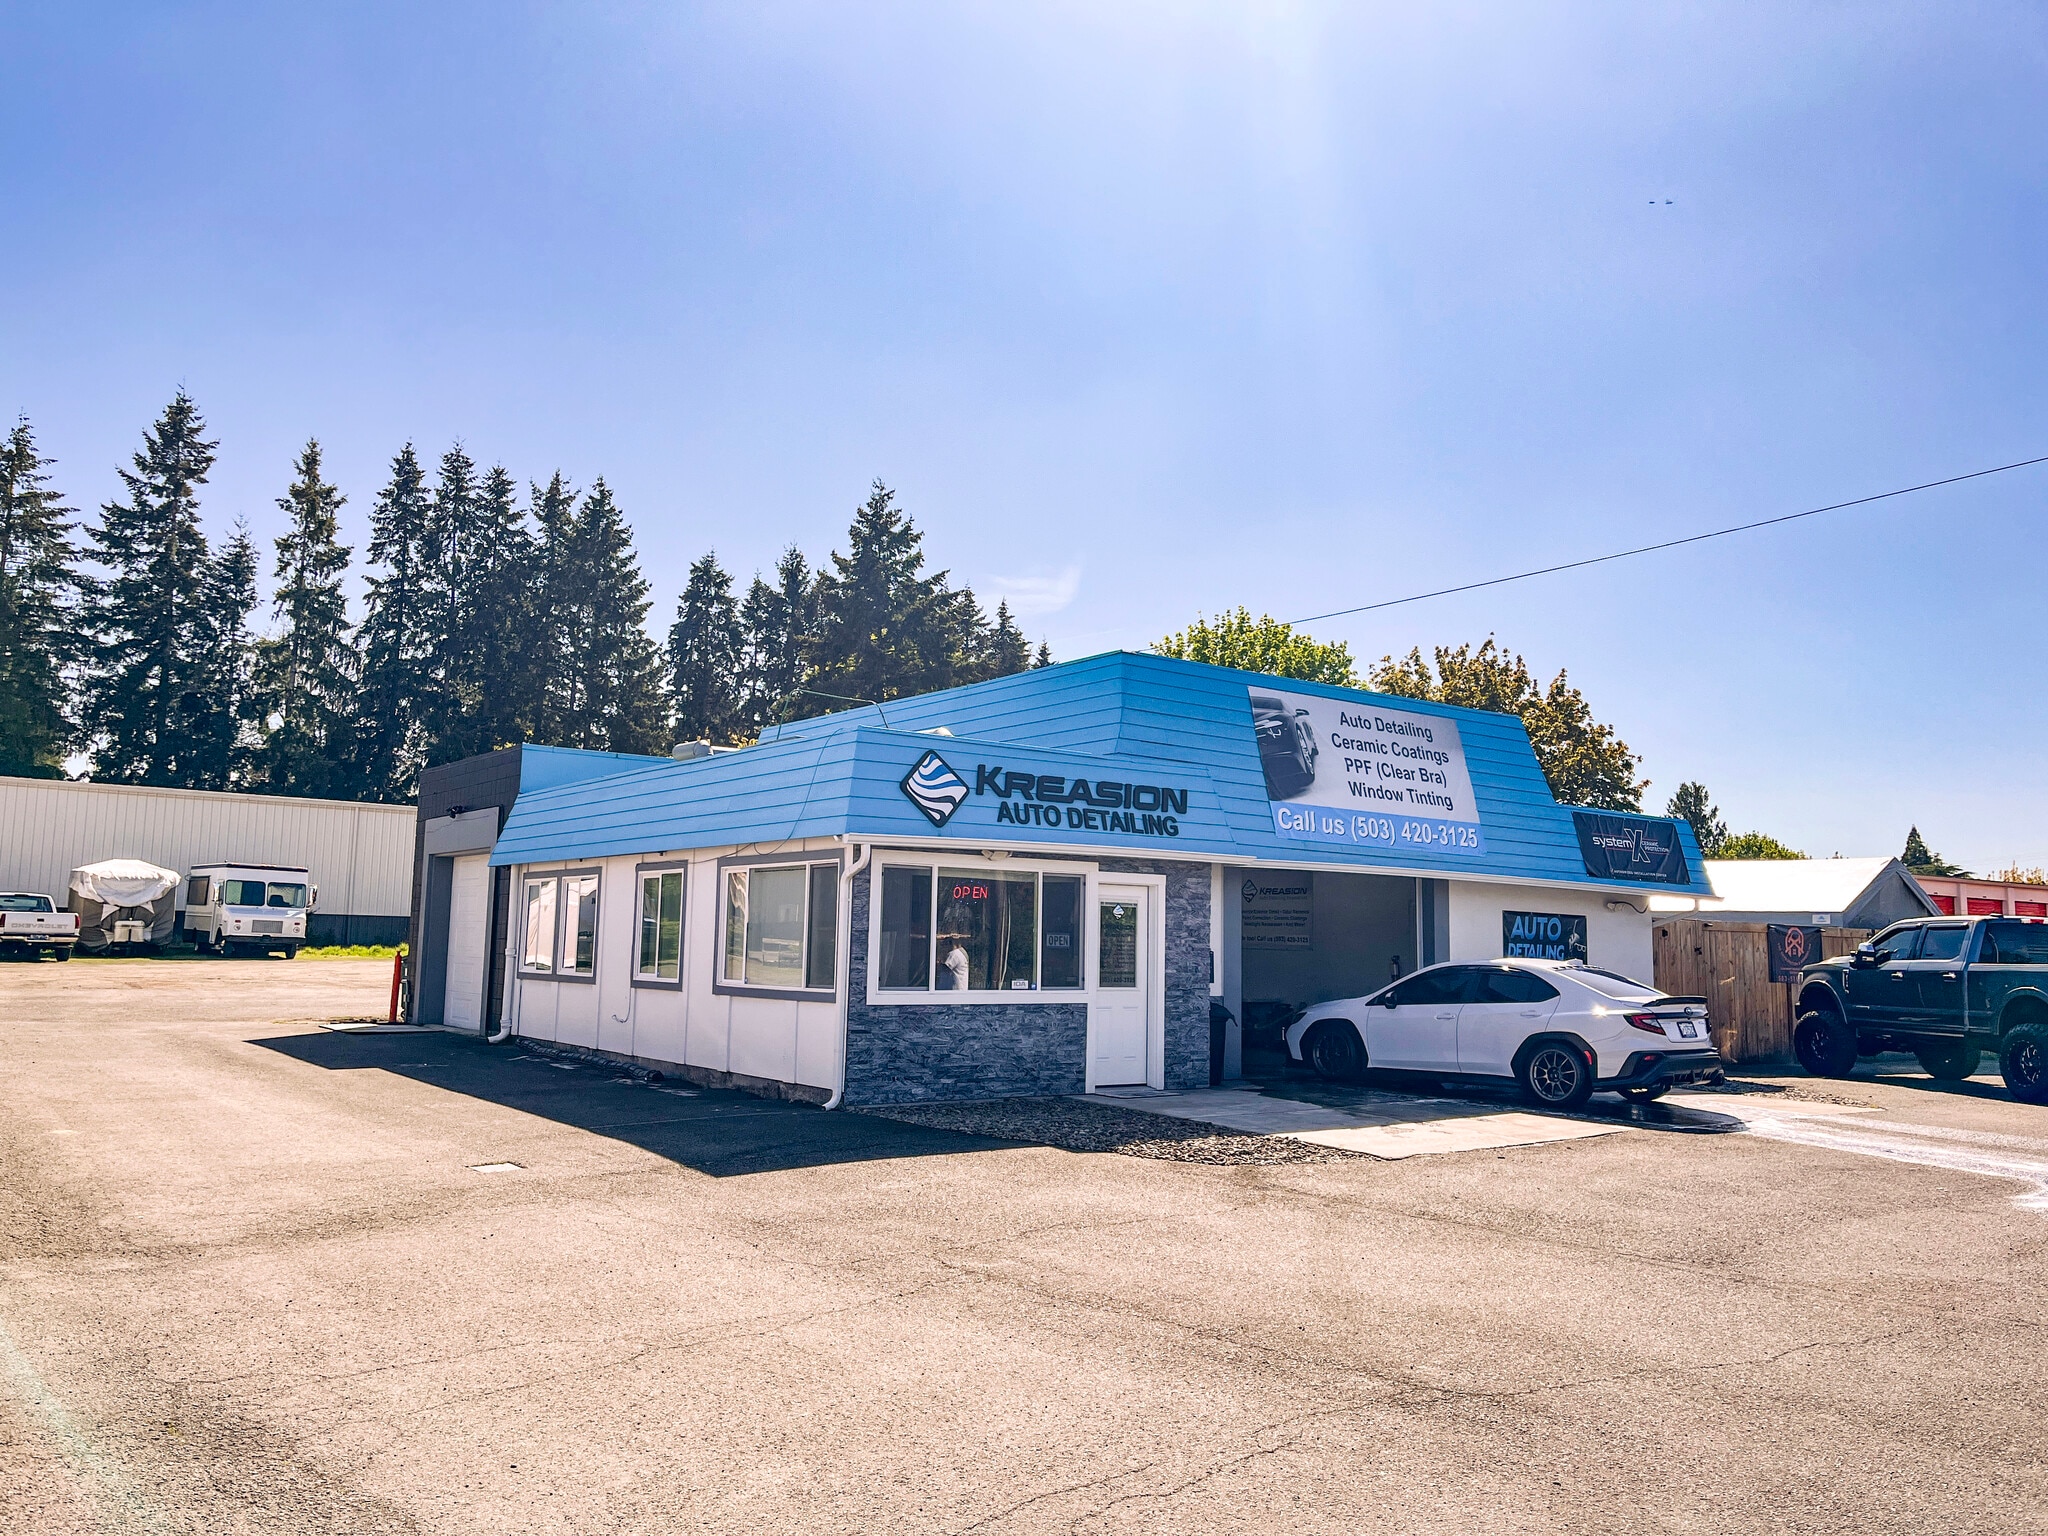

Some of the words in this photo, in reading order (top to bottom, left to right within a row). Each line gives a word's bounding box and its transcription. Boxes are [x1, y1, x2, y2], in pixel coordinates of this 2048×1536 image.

[1340, 711, 1372, 730] Auto
[1375, 717, 1433, 743] Detailing
[1331, 733, 1388, 755] Ceramic
[1391, 742, 1449, 766] Coatings
[1344, 757, 1372, 775] PPF
[1377, 762, 1415, 781] (Clear
[1418, 767, 1447, 788] Bra)
[1348, 781, 1403, 802] Window
[1406, 788, 1453, 811] Tinting
[997, 801, 1062, 827] AUTO
[1066, 807, 1180, 836] DETAILING
[1277, 807, 1316, 832] Call
[1322, 817, 1346, 836] us
[1351, 815, 1396, 846] (503)
[1401, 821, 1478, 848] 420-3125
[1592, 836, 1633, 848] system
[953, 886, 988, 899] OPEN
[1048, 935, 1069, 946] OPEN
[1510, 915, 1561, 941] AUTO
[1508, 942, 1565, 960] DETAILING
